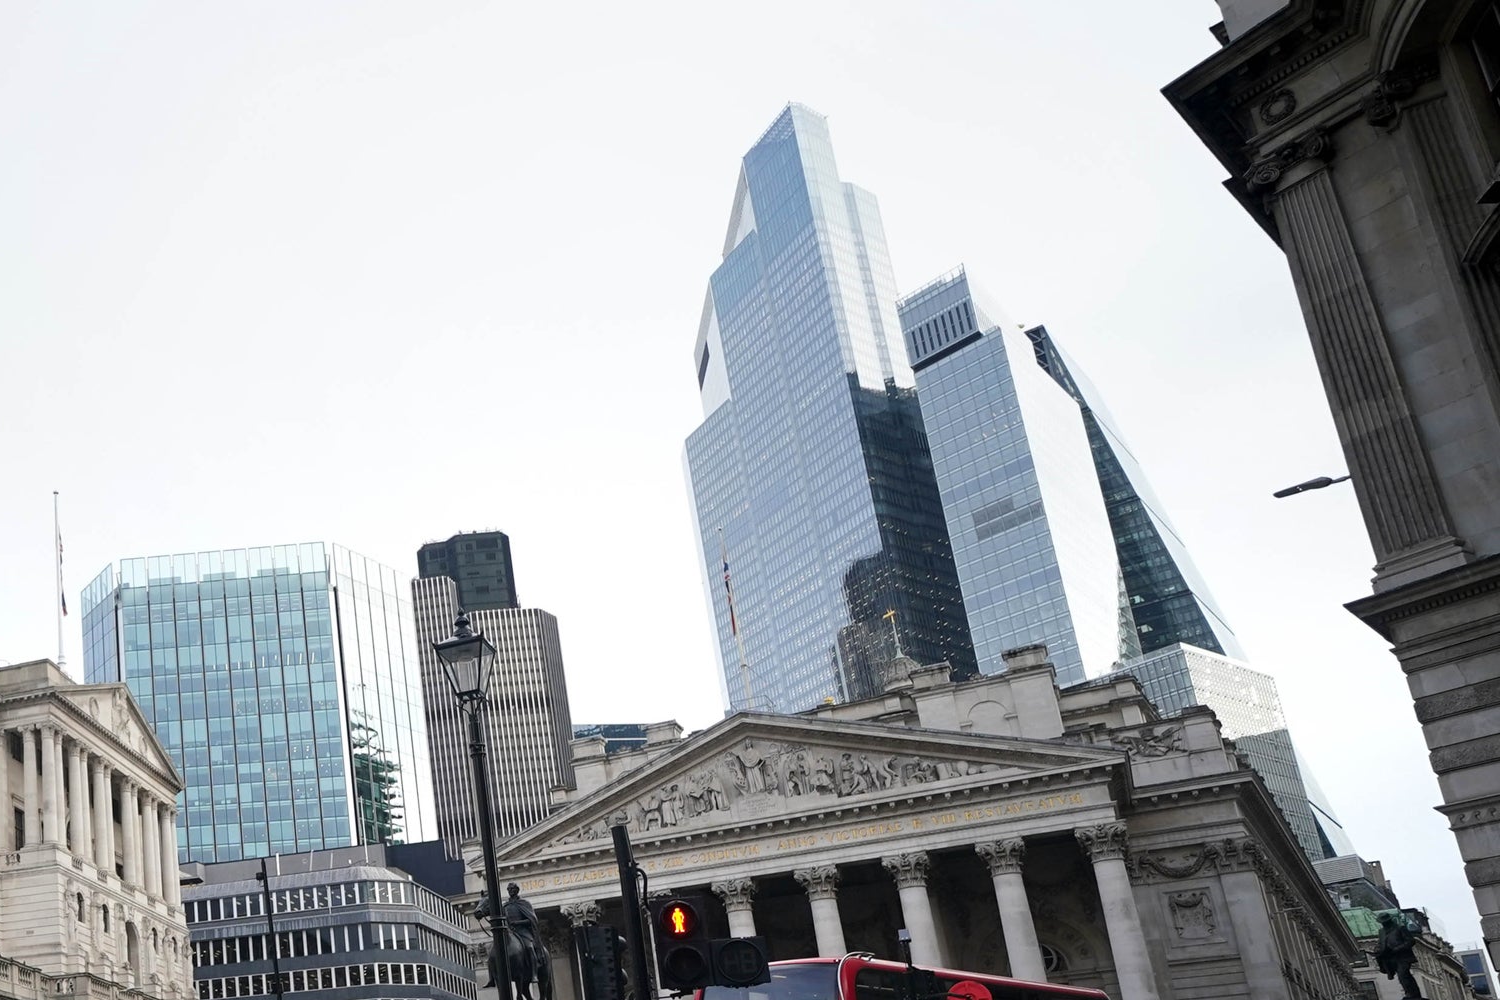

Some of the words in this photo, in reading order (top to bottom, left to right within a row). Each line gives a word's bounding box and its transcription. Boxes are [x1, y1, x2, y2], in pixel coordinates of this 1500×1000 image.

[521, 878, 546, 891] NNO
[690, 844, 760, 864] CONDITVM
[776, 834, 816, 850] ANNO
[824, 821, 905, 843] VICTORIAE
